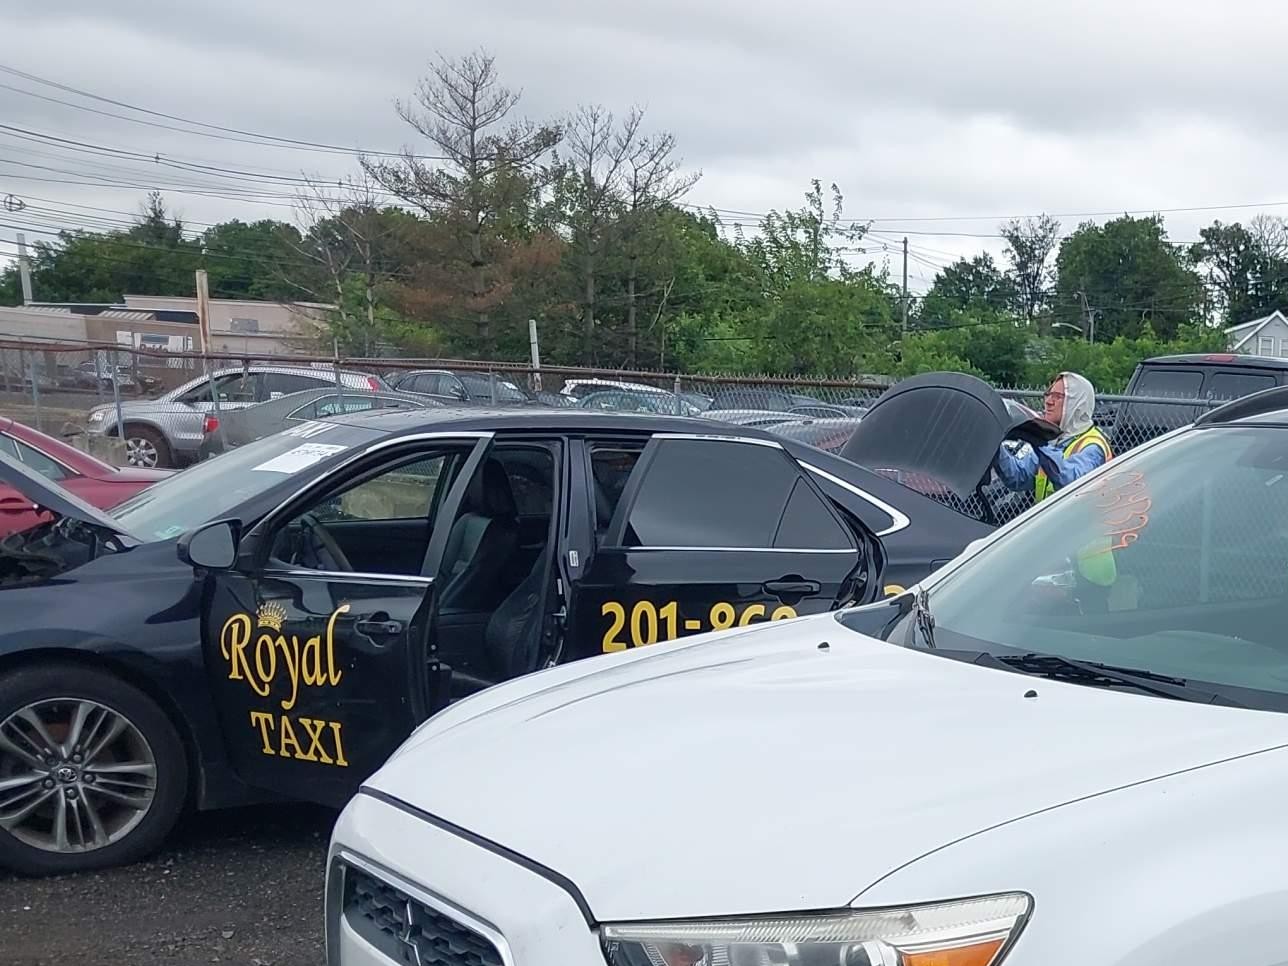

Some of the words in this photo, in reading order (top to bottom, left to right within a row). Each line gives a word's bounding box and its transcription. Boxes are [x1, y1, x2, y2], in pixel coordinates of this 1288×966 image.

[602, 601, 798, 653] 201-8
[221, 604, 350, 710] Royal
[250, 711, 349, 767] TAXI
